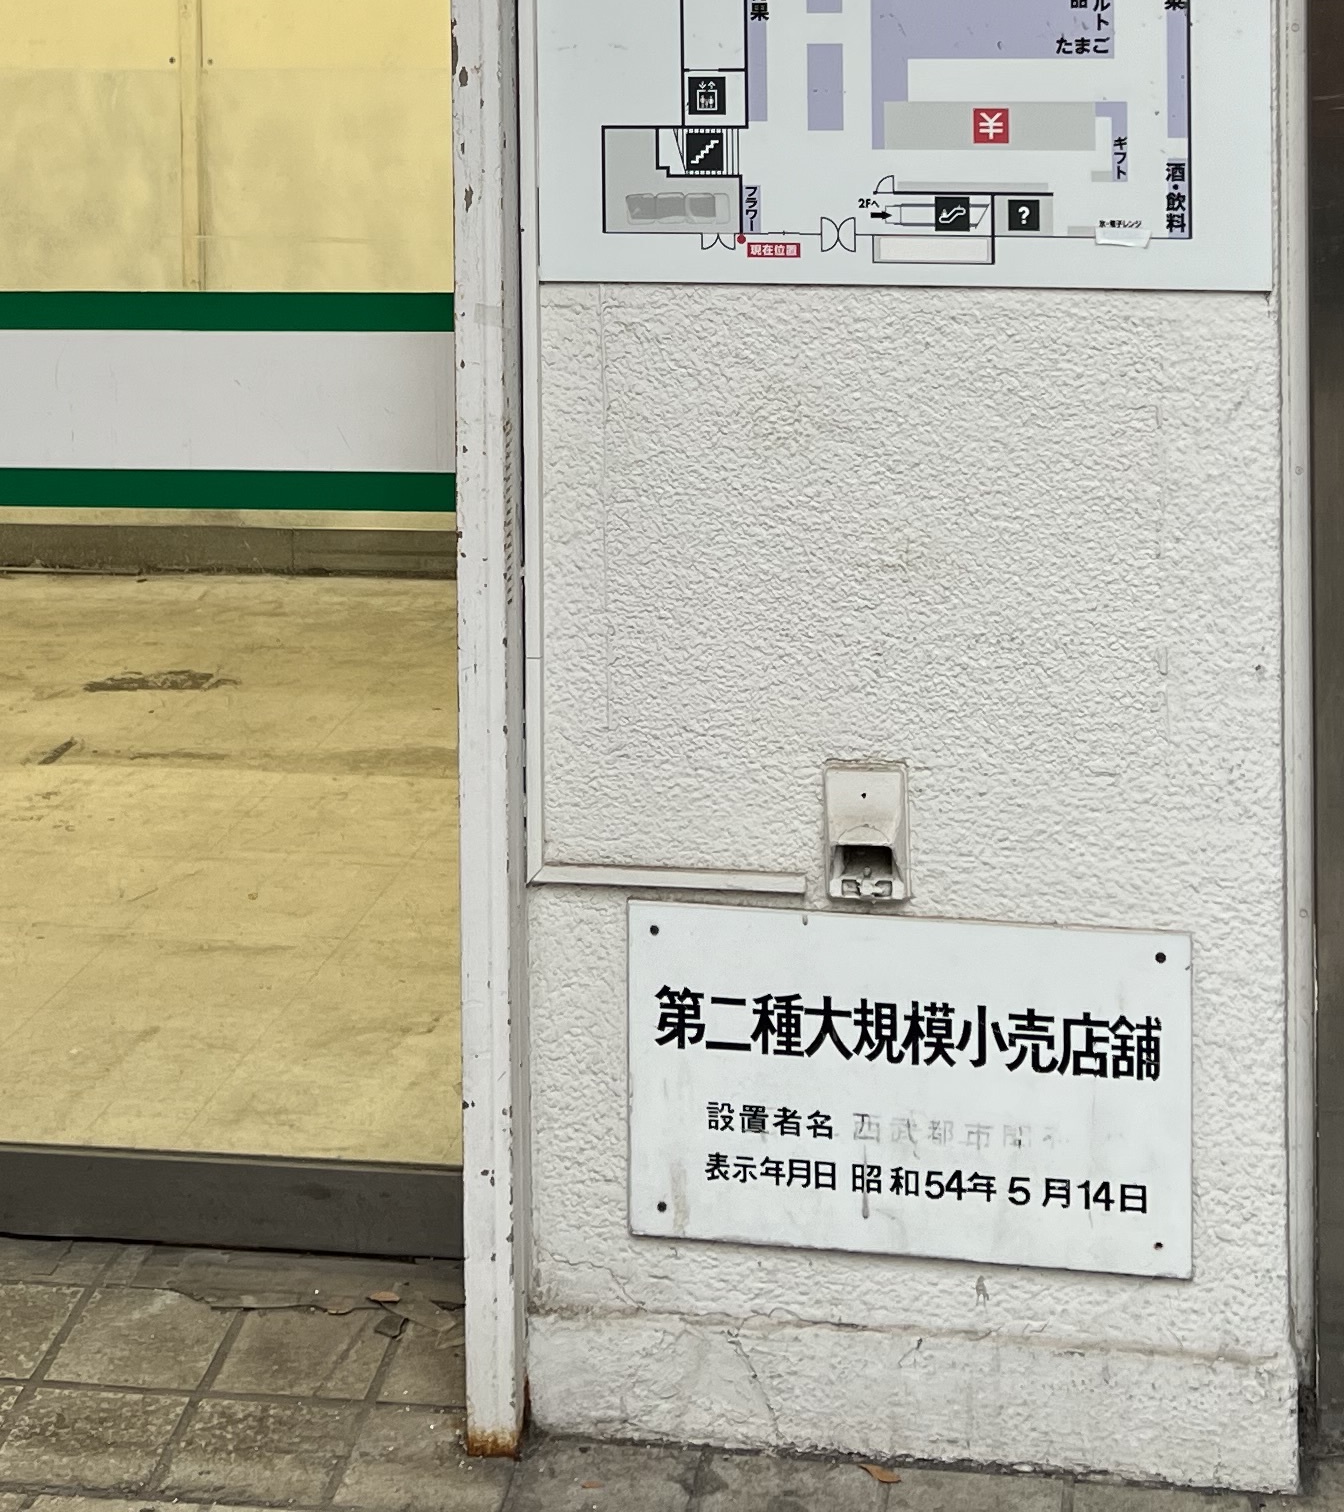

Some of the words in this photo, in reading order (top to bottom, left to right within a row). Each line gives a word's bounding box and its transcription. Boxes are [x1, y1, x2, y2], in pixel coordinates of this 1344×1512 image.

[1055, 37, 1110, 55] たまご
[1113, 136, 1128, 180] ギフト
[745, 185, 758, 232] フラワー
[858, 198, 880, 209] 2Fへ
[1165, 162, 1187, 234] 酒・飲料
[749, 243, 798, 257] 現在位置
[654, 983, 1163, 1082] 第二種大規模小売店舗
[706, 1101, 835, 1141] 設置者名
[705, 1151, 837, 1192] 表示年月日
